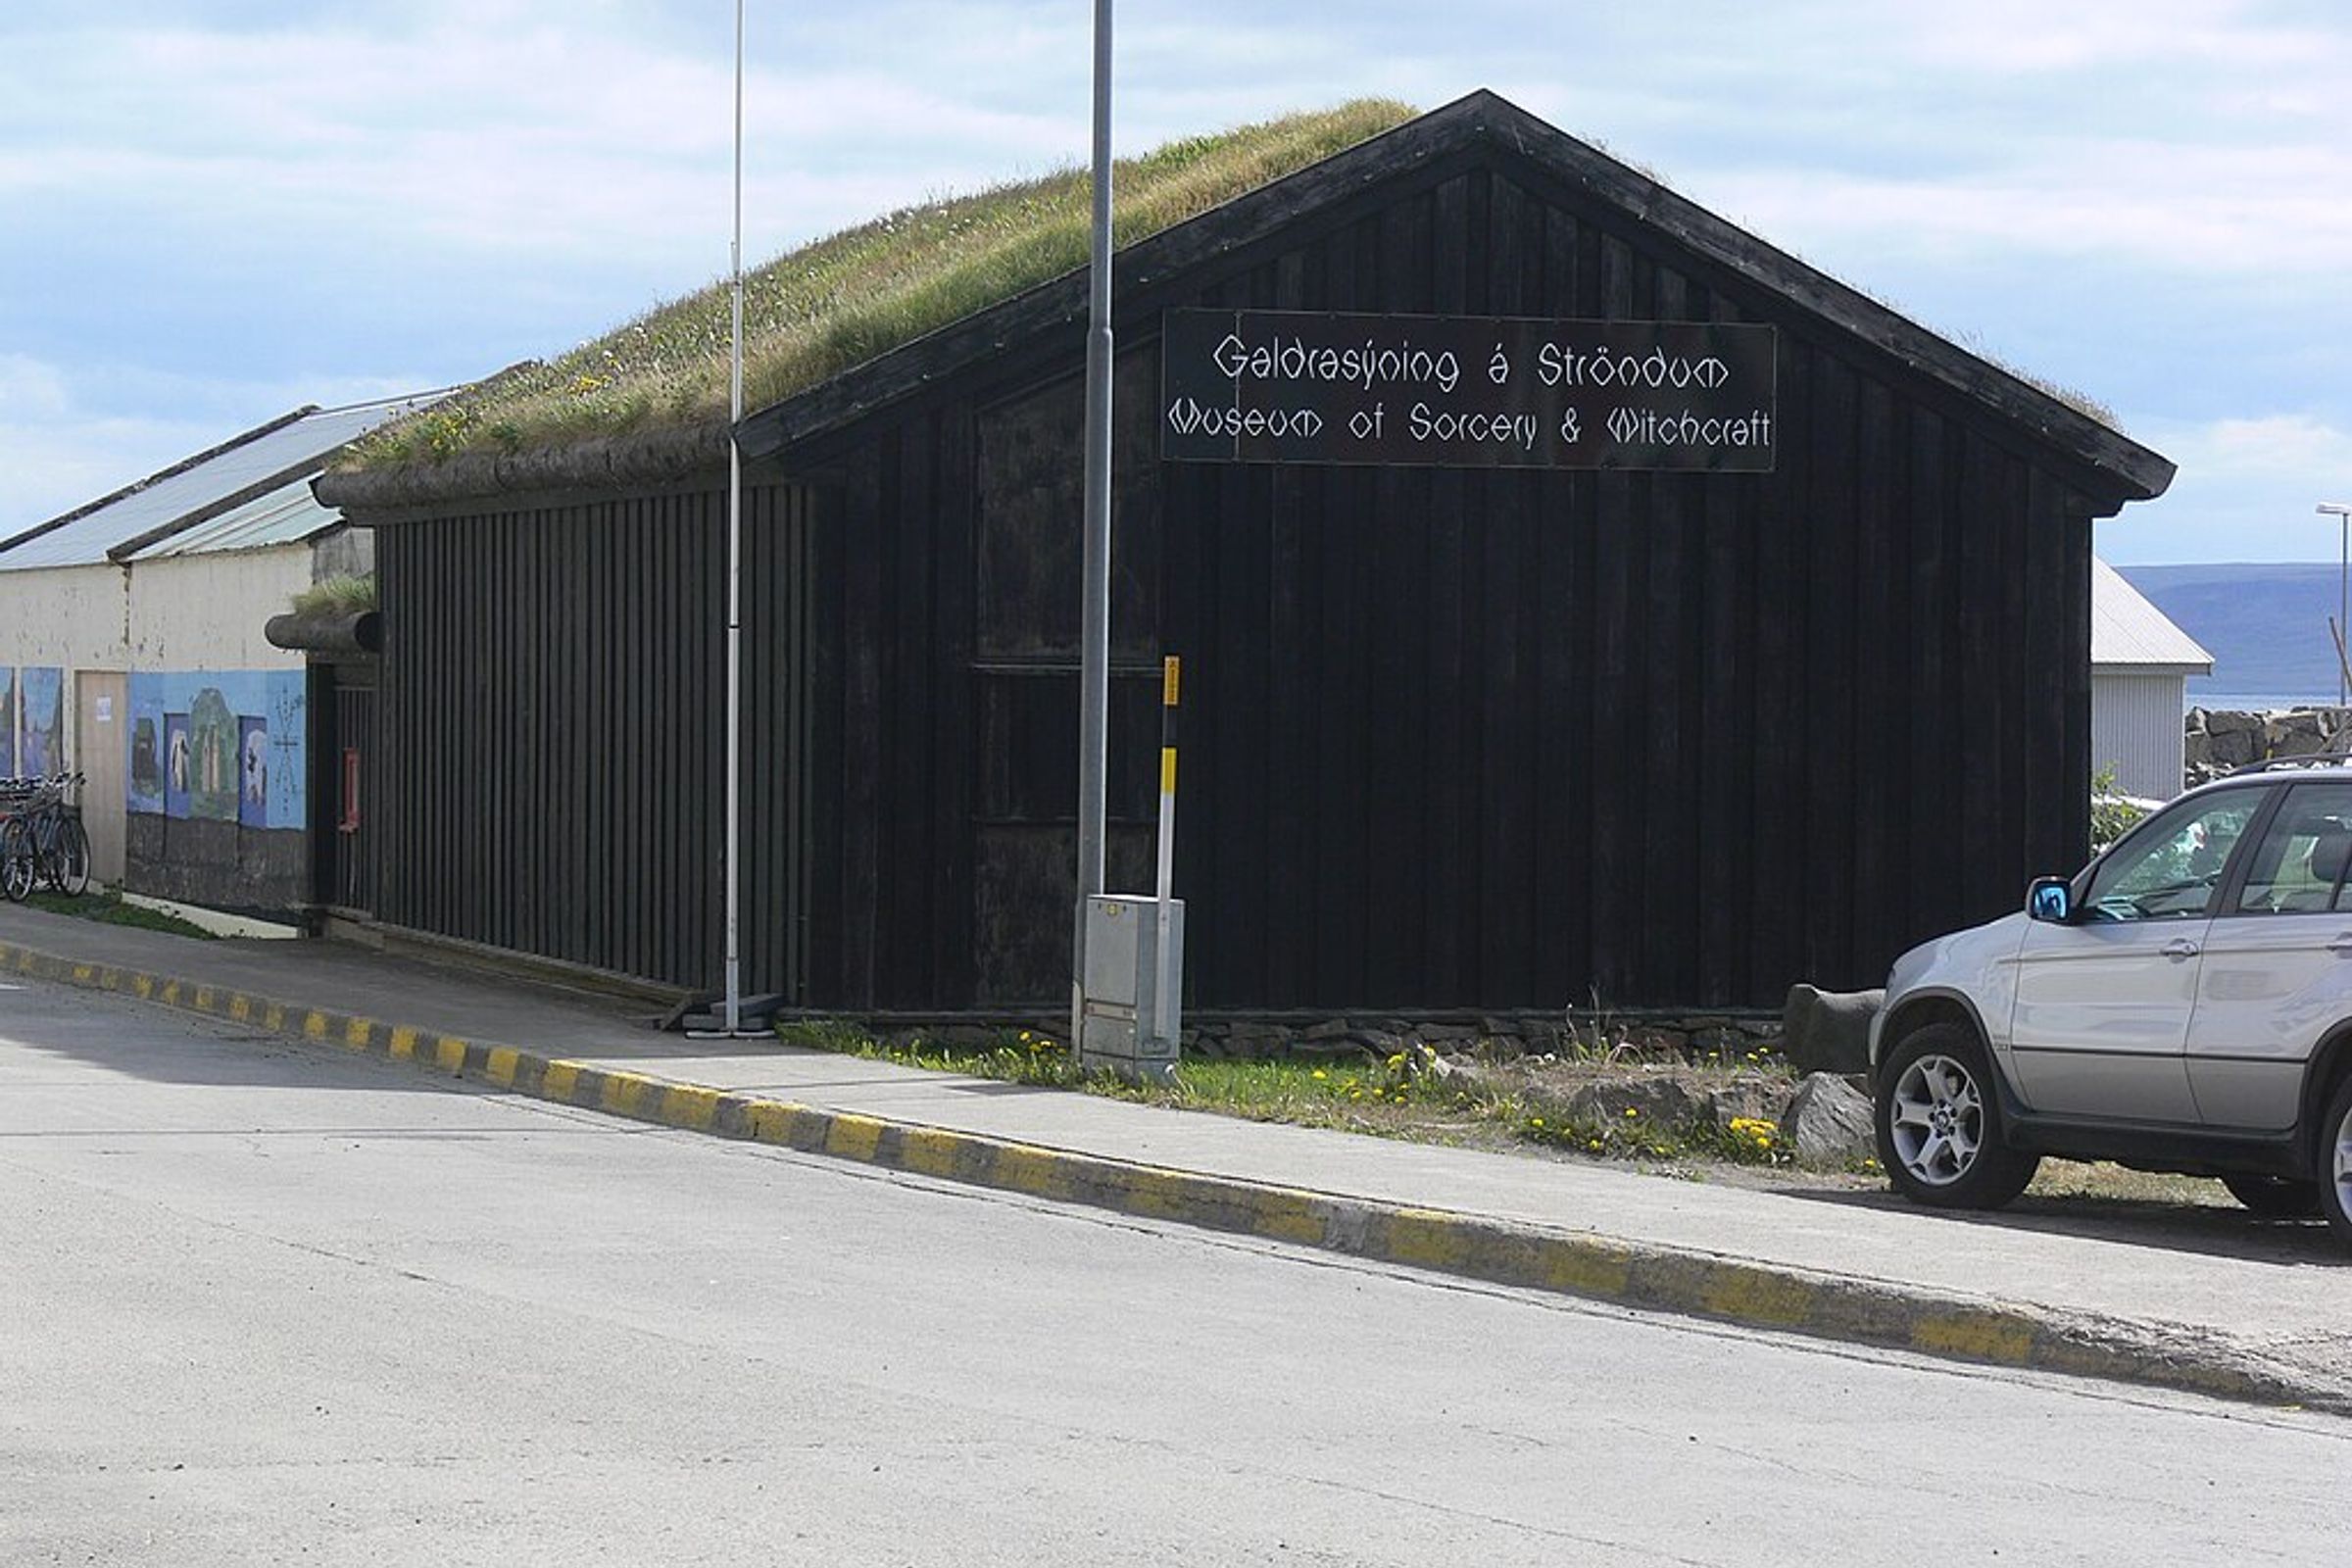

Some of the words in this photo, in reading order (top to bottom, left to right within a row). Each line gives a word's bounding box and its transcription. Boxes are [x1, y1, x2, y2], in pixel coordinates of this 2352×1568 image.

[1212, 333, 1460, 393] Galdrasýning
[1488, 343, 1510, 384] á
[1538, 343, 1729, 388] Ströndum
[1168, 397, 1323, 437] Museum
[1348, 402, 1385, 439] of
[1409, 402, 1537, 450] Sorcery
[1560, 407, 1582, 444] &
[1606, 407, 1771, 446] Witchcraft
